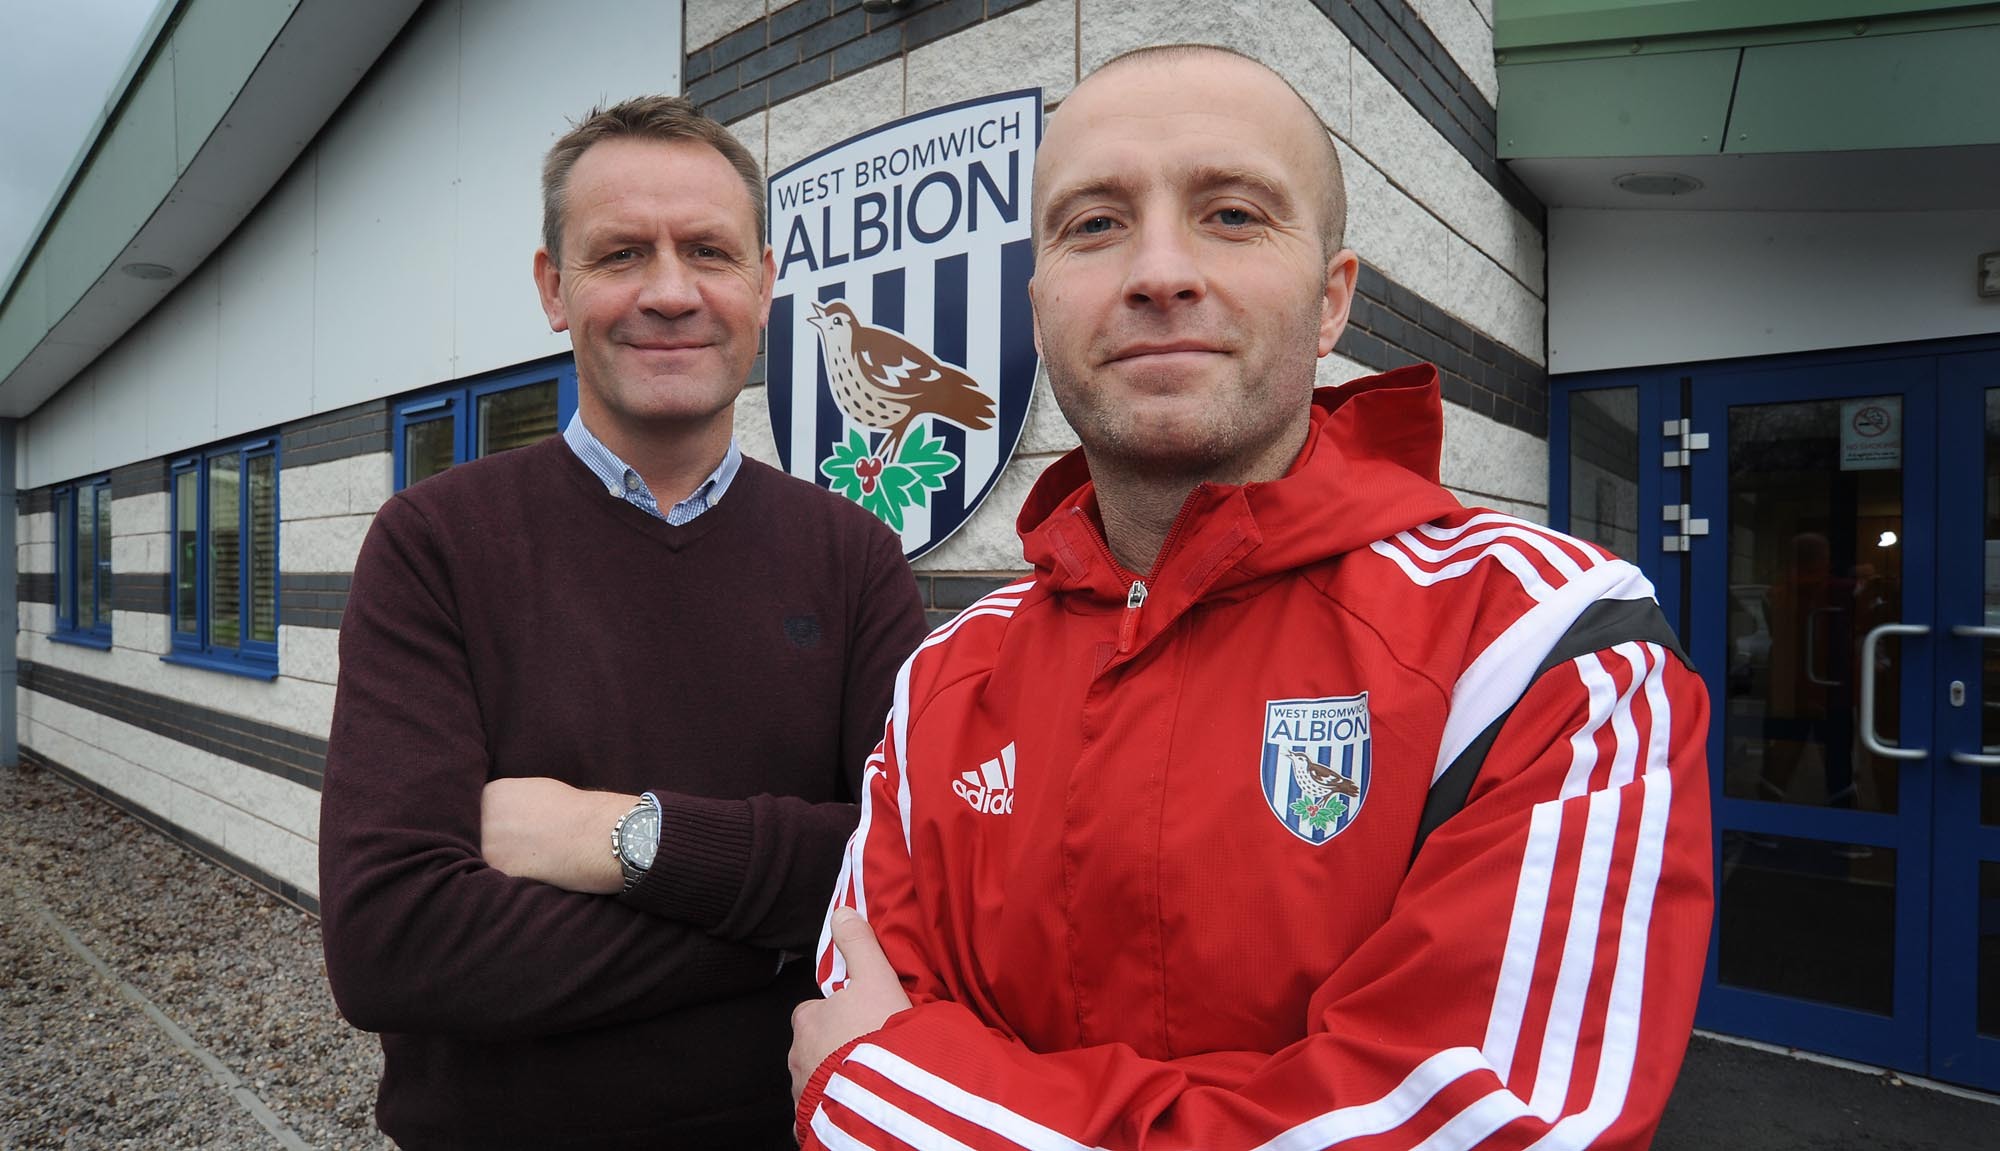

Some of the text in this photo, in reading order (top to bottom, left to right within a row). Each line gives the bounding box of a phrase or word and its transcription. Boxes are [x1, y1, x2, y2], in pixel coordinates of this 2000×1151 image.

[777, 111, 1020, 212] WEST BROMWICH
[777, 149, 1019, 281] ALBION
[1271, 712, 1368, 742] ALBION
[1273, 708, 1308, 719] WEST
